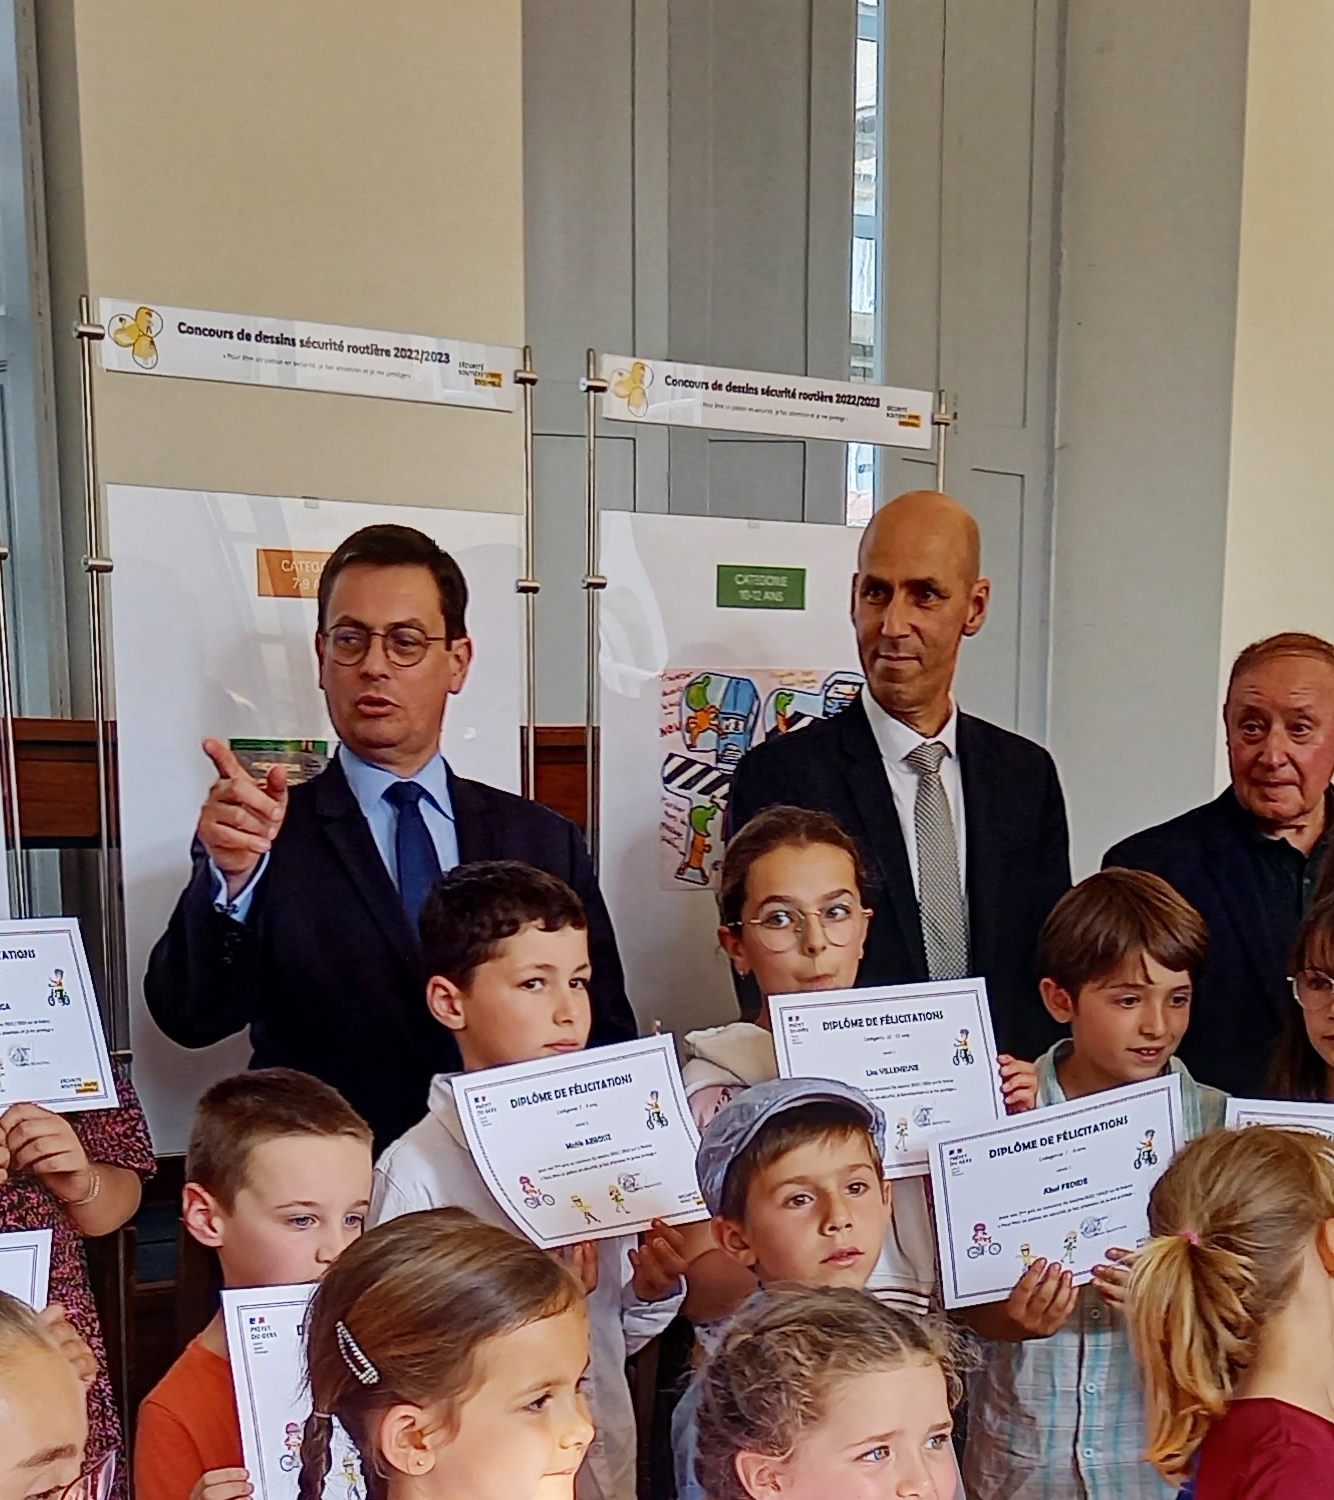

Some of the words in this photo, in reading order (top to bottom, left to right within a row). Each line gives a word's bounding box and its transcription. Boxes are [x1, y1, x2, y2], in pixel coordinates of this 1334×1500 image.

[177, 321, 234, 340] Concours
[237, 328, 252, 342] de
[255, 330, 296, 348] dessins
[299, 336, 344, 351] sécurité
[347, 342, 391, 358] routière
[393, 347, 450, 364] 2022/2023
[664, 374, 709, 390] Concours
[711, 380, 723, 391] de
[726, 381, 758, 395] dessins
[761, 385, 797, 400] sécurité
[798, 390, 834, 404] routière
[835, 393, 880, 408] 2022/2023
[822, 1016, 864, 1032] DIPLÔME
[866, 1016, 879, 1027] DE
[880, 1010, 944, 1026] FÉLICITATIONS
[510, 1091, 553, 1109] DIPLÔME
[554, 1088, 568, 1100] DE
[568, 1073, 633, 1097] FÉLICITATIONS
[988, 1139, 1038, 1160] DIPLÔME
[1039, 1135, 1055, 1148] DE
[1056, 1114, 1129, 1144] FÉLICITATIONS
